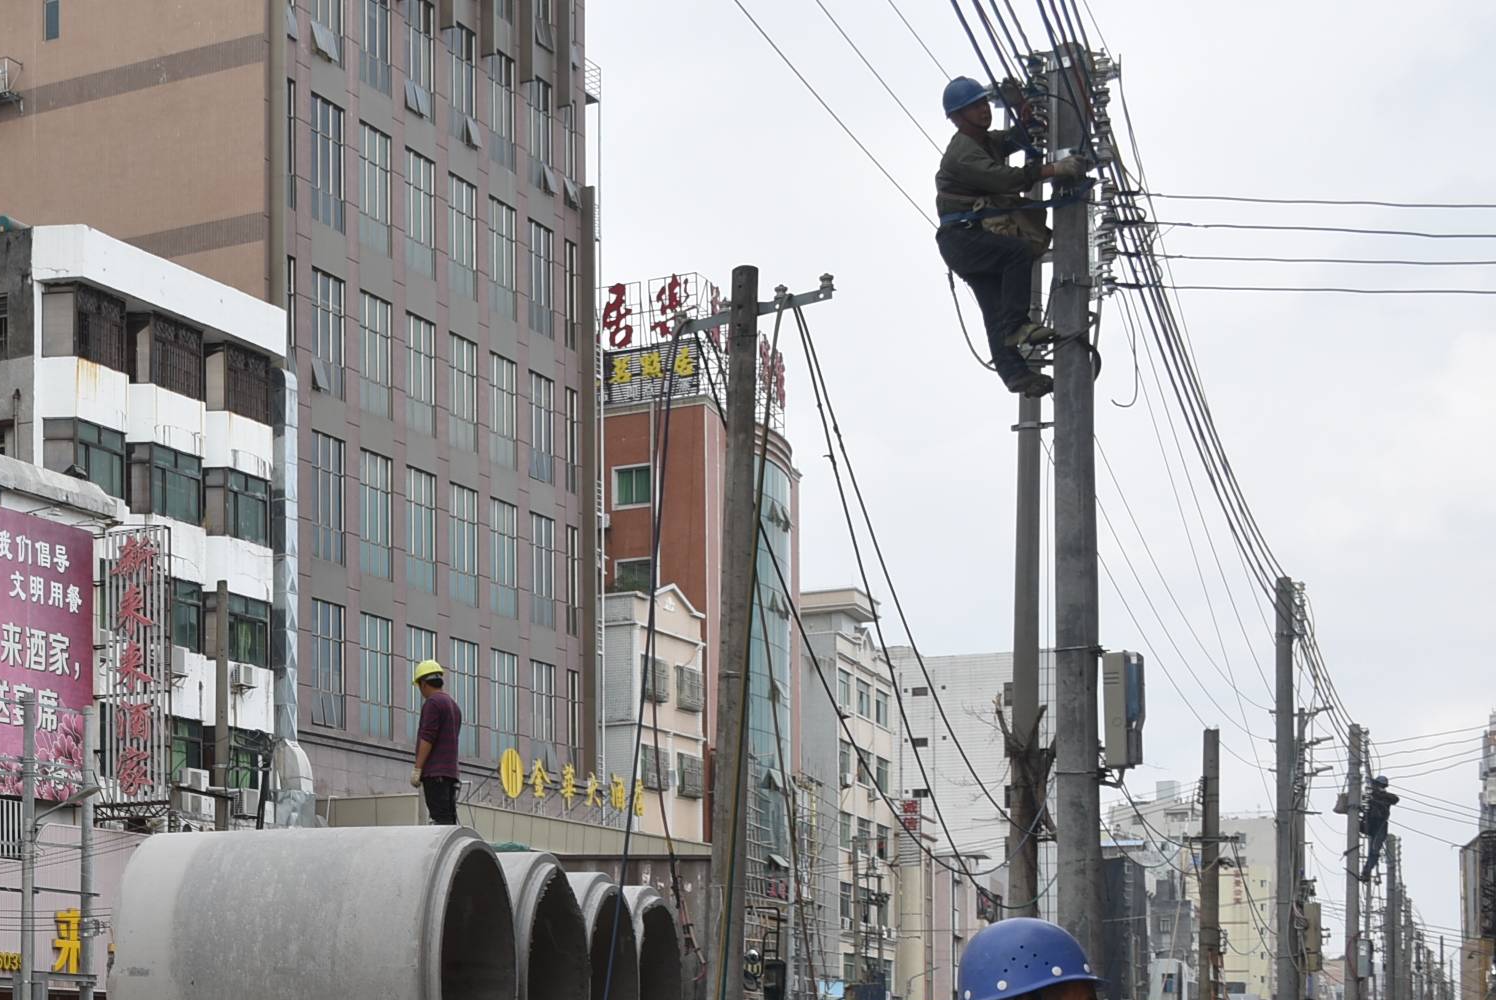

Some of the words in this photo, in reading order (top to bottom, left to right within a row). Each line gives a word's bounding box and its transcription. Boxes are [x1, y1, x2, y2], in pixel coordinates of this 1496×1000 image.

[112, 536, 158, 797] 新来来酒家
